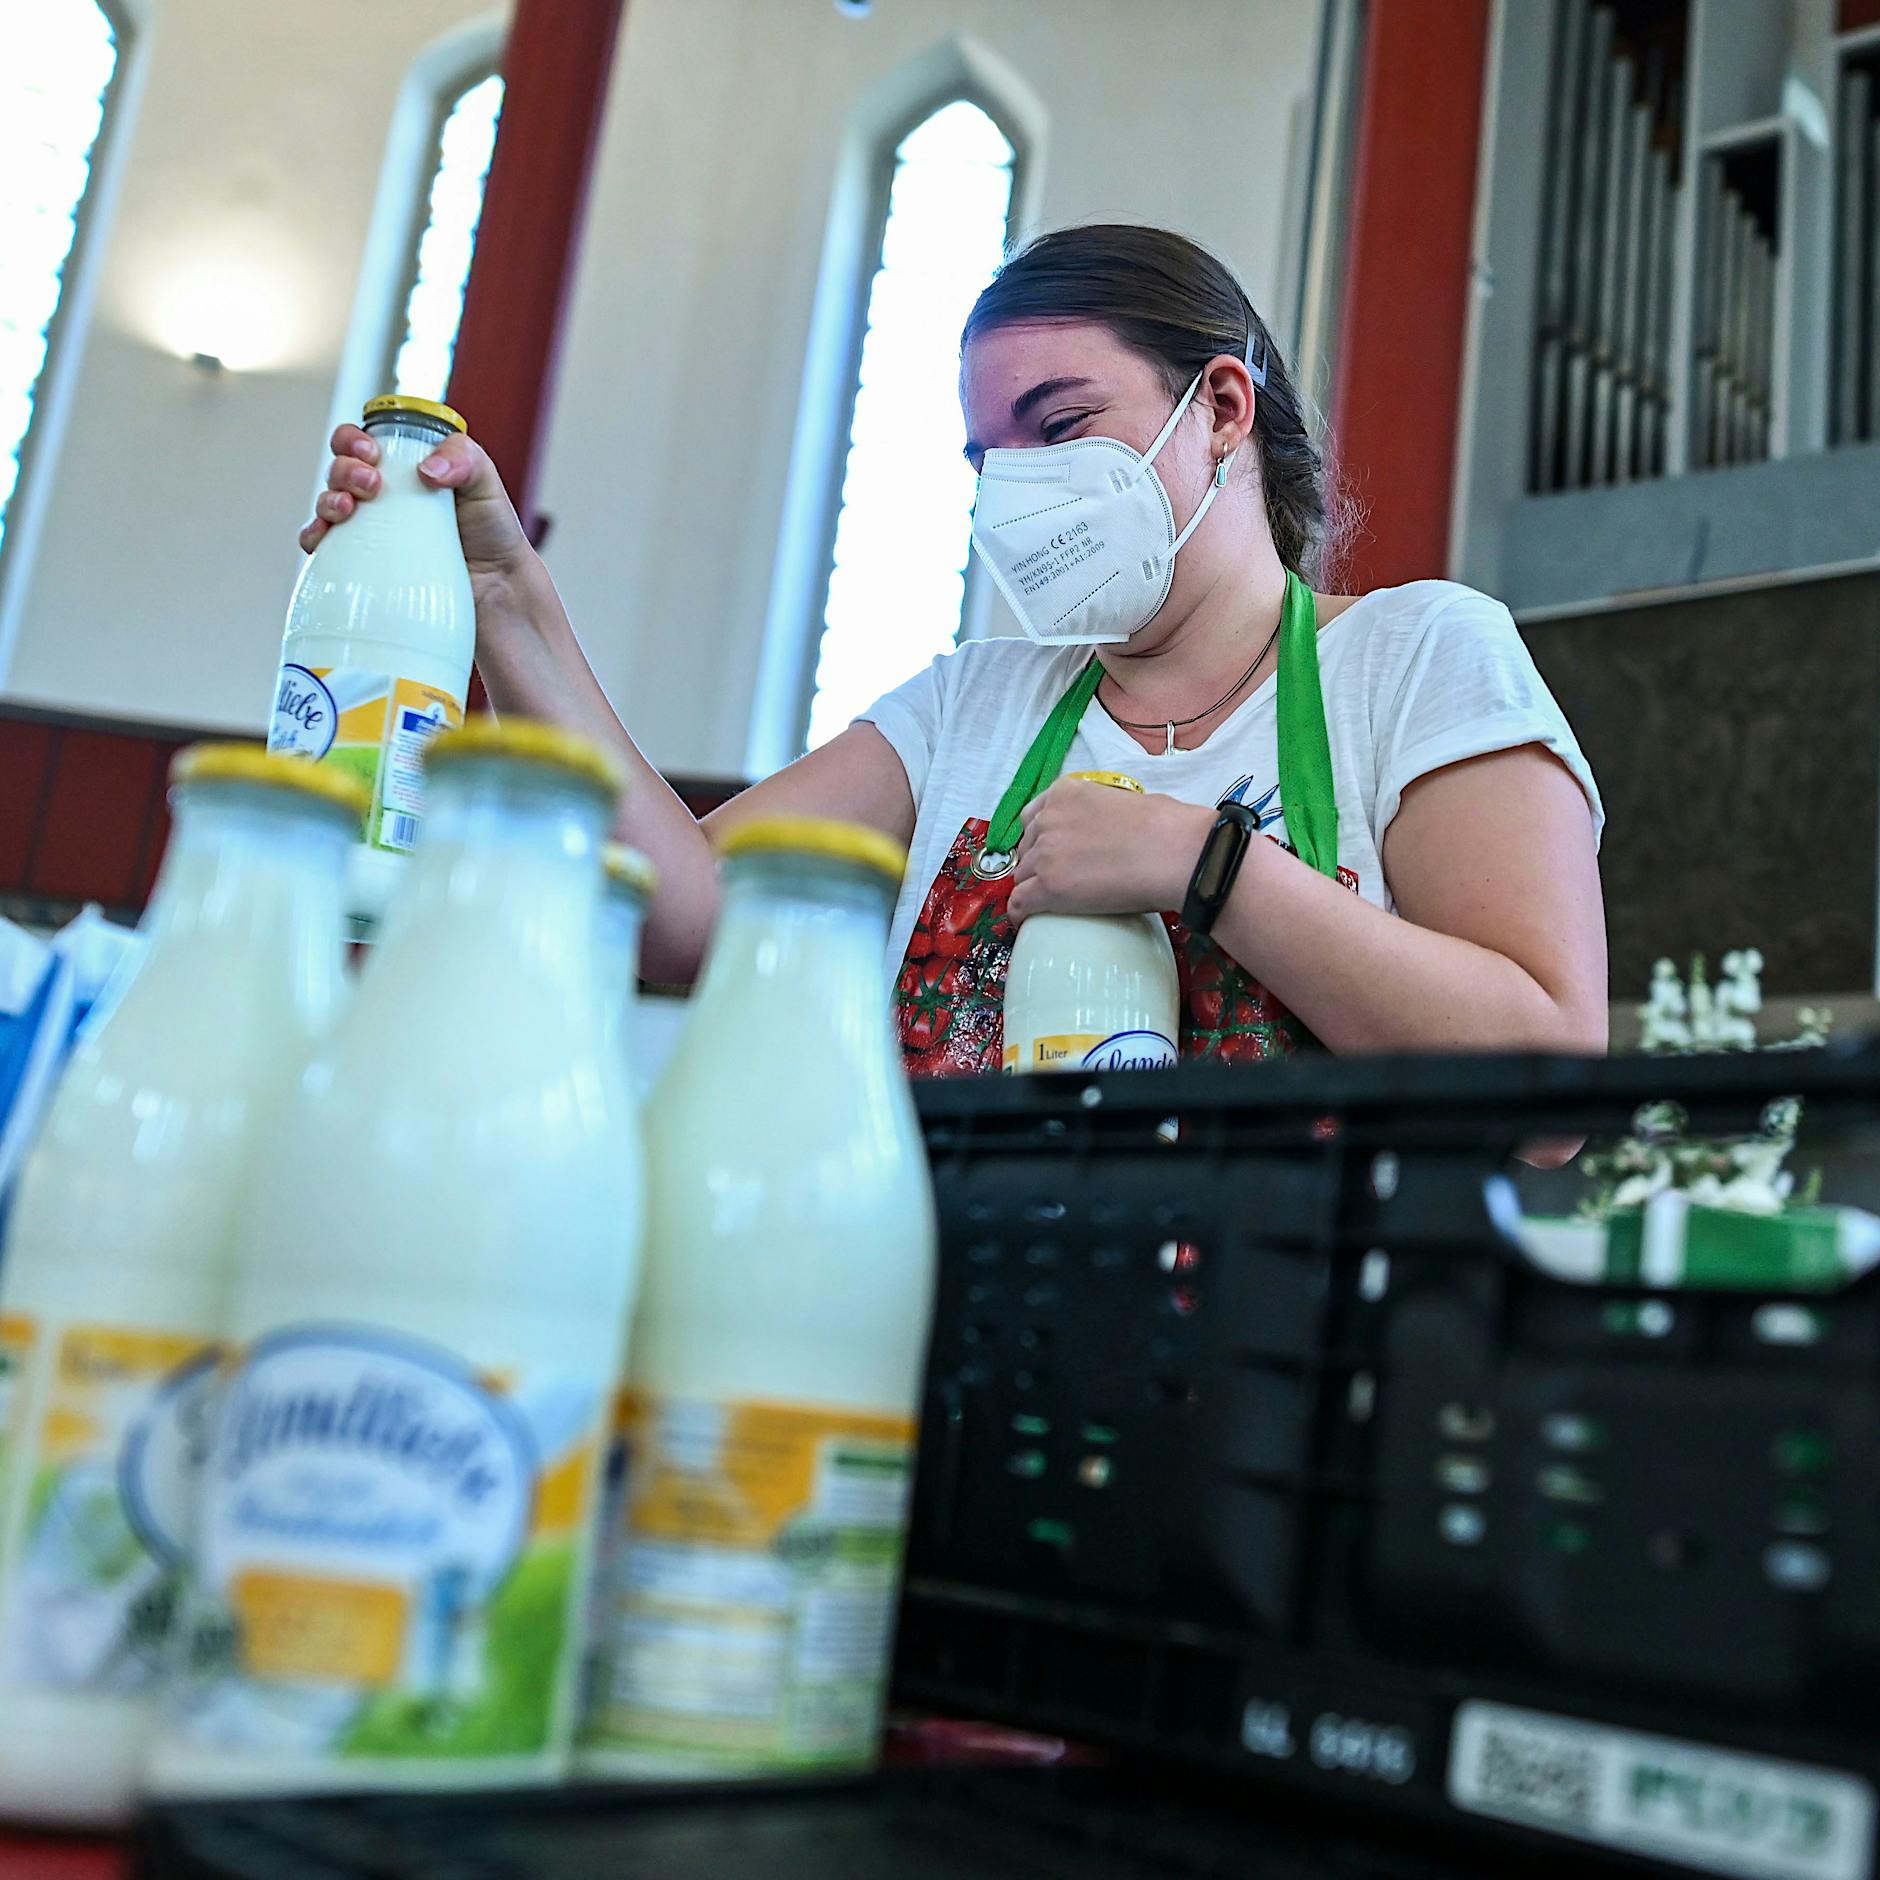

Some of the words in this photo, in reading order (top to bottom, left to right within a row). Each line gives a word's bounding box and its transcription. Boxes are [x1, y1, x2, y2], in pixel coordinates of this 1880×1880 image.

[1065, 521, 1089, 541] 2163
[1059, 544, 1080, 564] FFP2
[1081, 536, 1093, 548] NR
[1039, 1044, 1044, 1061] 1
[1046, 1048, 1068, 1060] Liter
